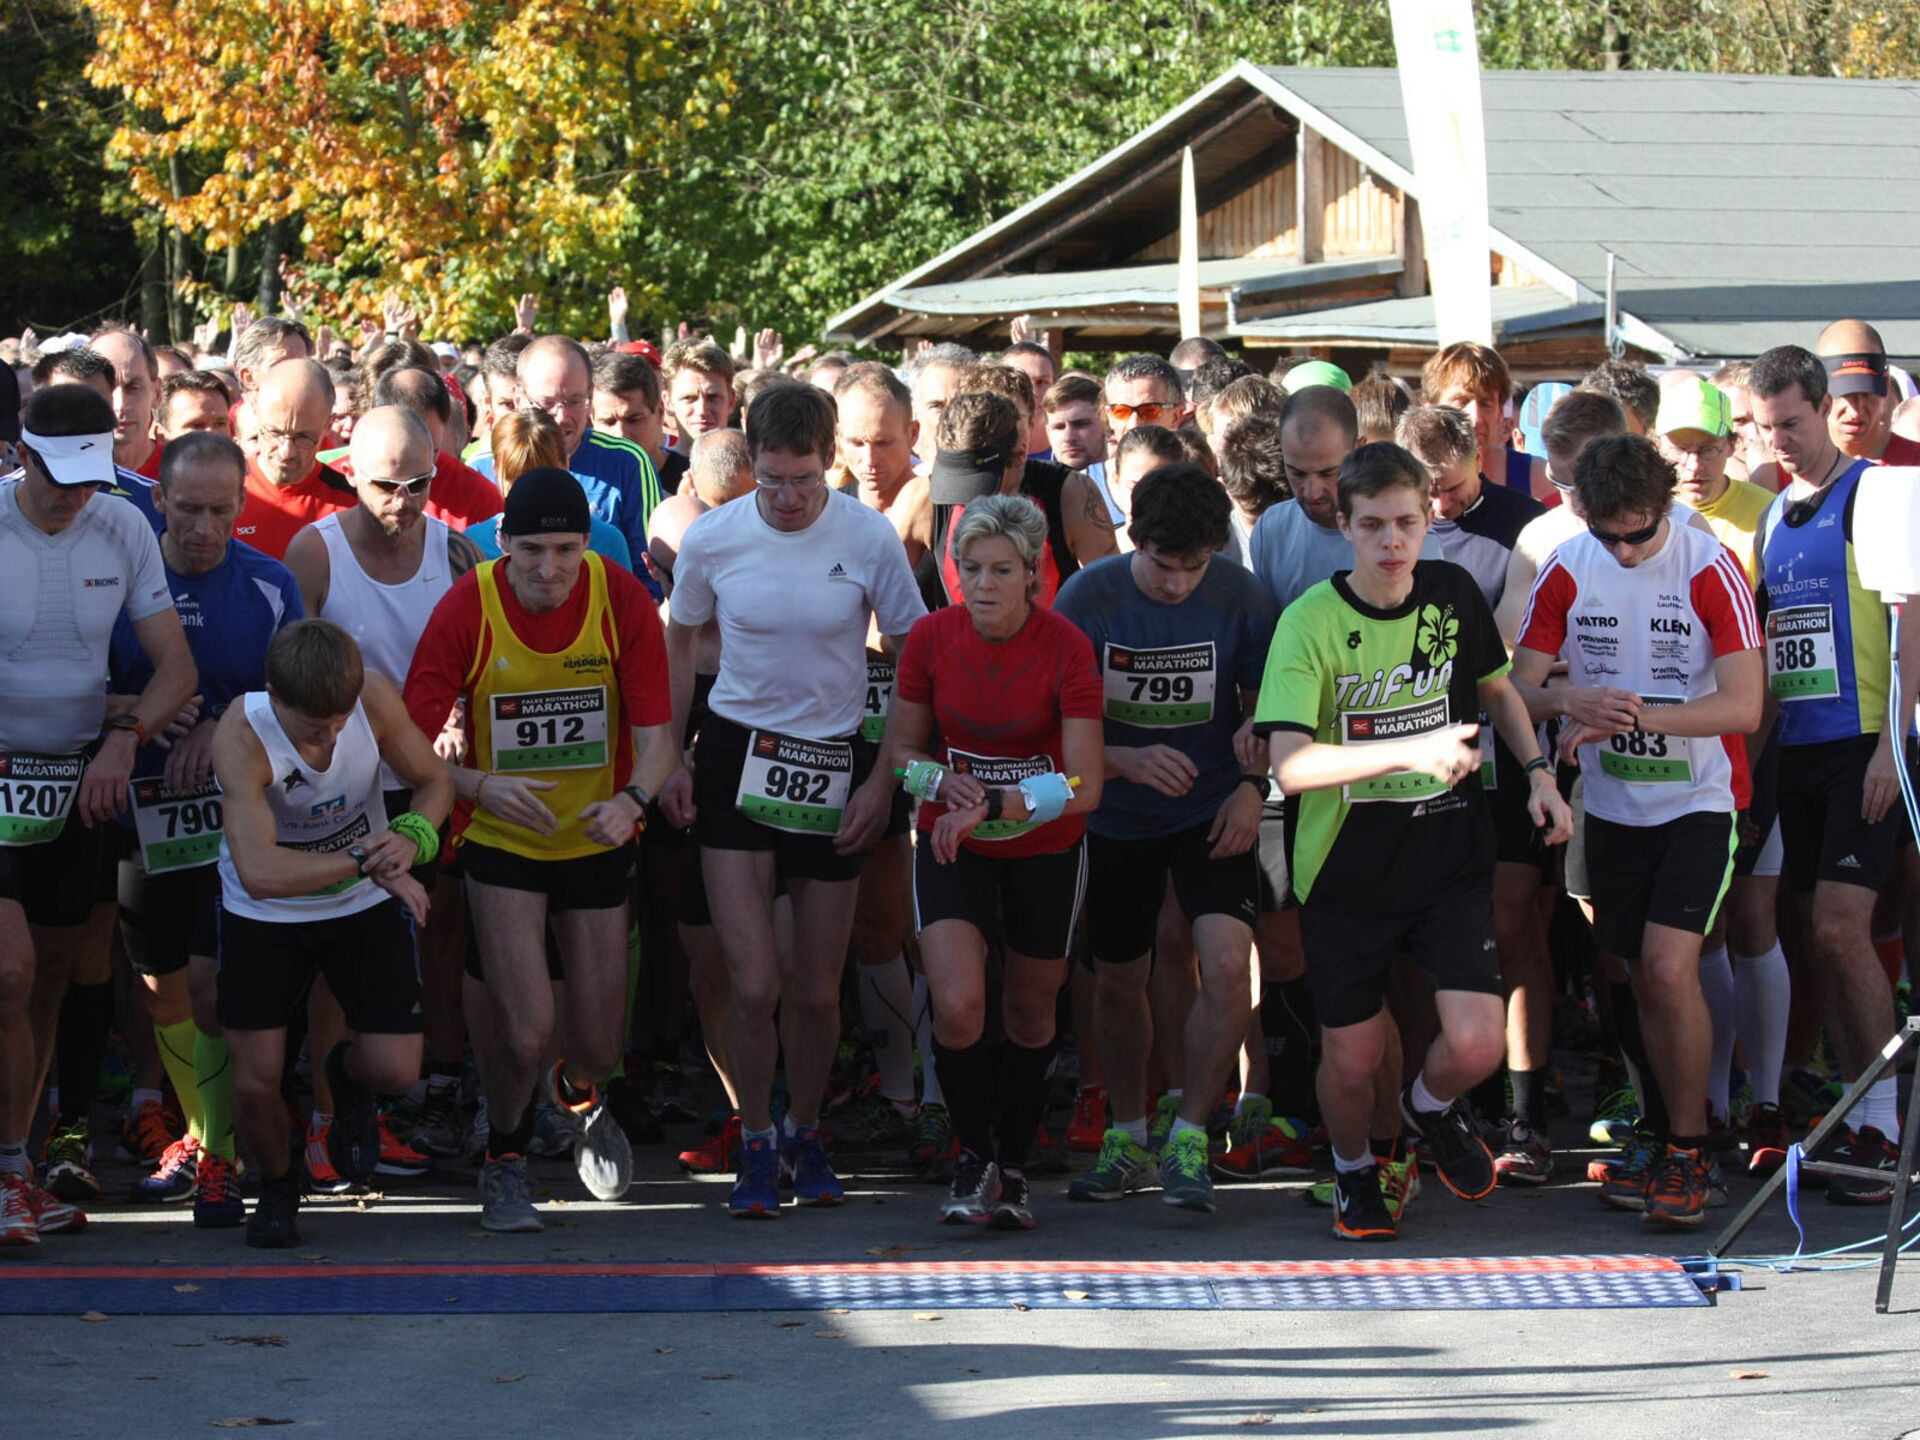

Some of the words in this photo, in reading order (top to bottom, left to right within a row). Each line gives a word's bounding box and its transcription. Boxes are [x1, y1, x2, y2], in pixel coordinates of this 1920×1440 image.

[180, 611, 205, 627] ank
[1575, 616, 1619, 628] VATRO
[1777, 618, 1826, 632] MARATHON
[1775, 638, 1817, 672] 588
[1134, 658, 1209, 670] MARATHON
[1127, 675, 1194, 702] 799
[521, 699, 600, 714] MARATHON
[1374, 715, 1397, 725] FALKE
[1375, 712, 1445, 735] MARATHON
[516, 717, 585, 747] 912
[780, 740, 801, 750] FALKE
[778, 746, 849, 768] MARATHON
[12, 764, 79, 777] MARATHON
[972, 767, 1048, 782] MARATHON
[765, 765, 831, 804] 982
[1369, 775, 1436, 790] FALKE
[0, 782, 73, 818] 1207
[158, 800, 223, 838] 790
[760, 805, 824, 823] FALKE
